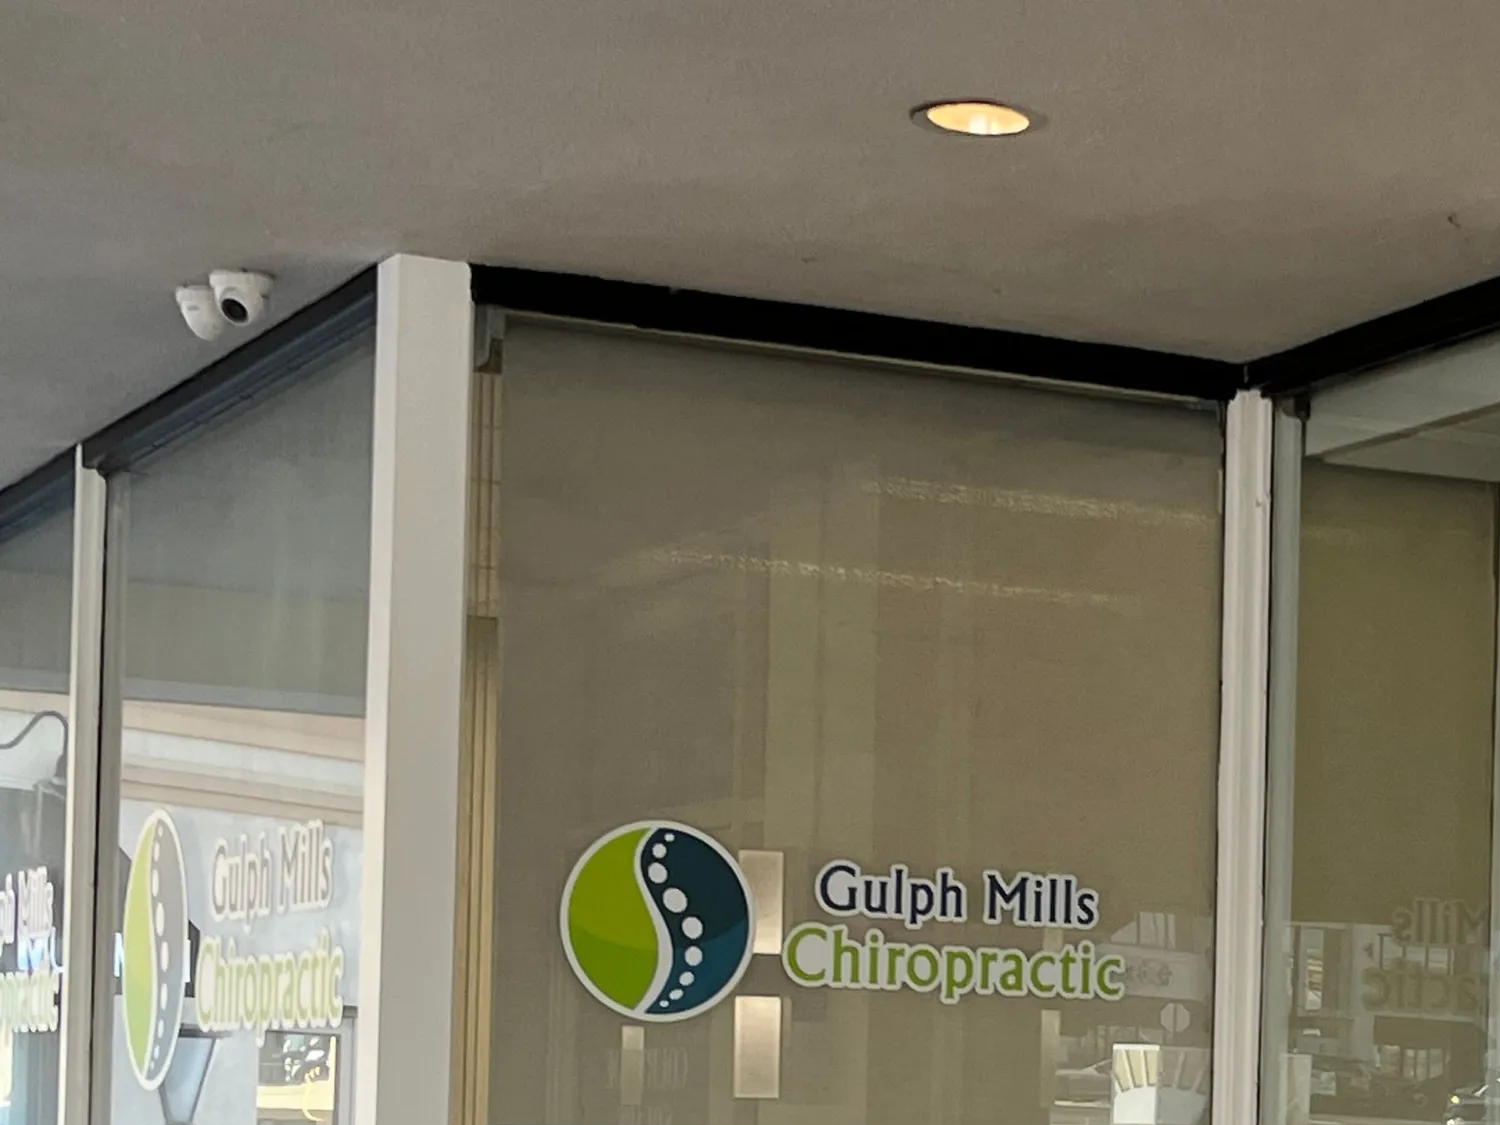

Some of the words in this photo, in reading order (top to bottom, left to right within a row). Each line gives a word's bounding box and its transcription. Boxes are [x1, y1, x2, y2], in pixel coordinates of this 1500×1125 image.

[213, 834, 272, 933] Gulph
[279, 820, 335, 913] Mills
[817, 861, 967, 928] Gulph
[982, 869, 1099, 928] Mills
[196, 931, 344, 1044] Chiropractic
[784, 925, 1127, 1002] Chiropractic
